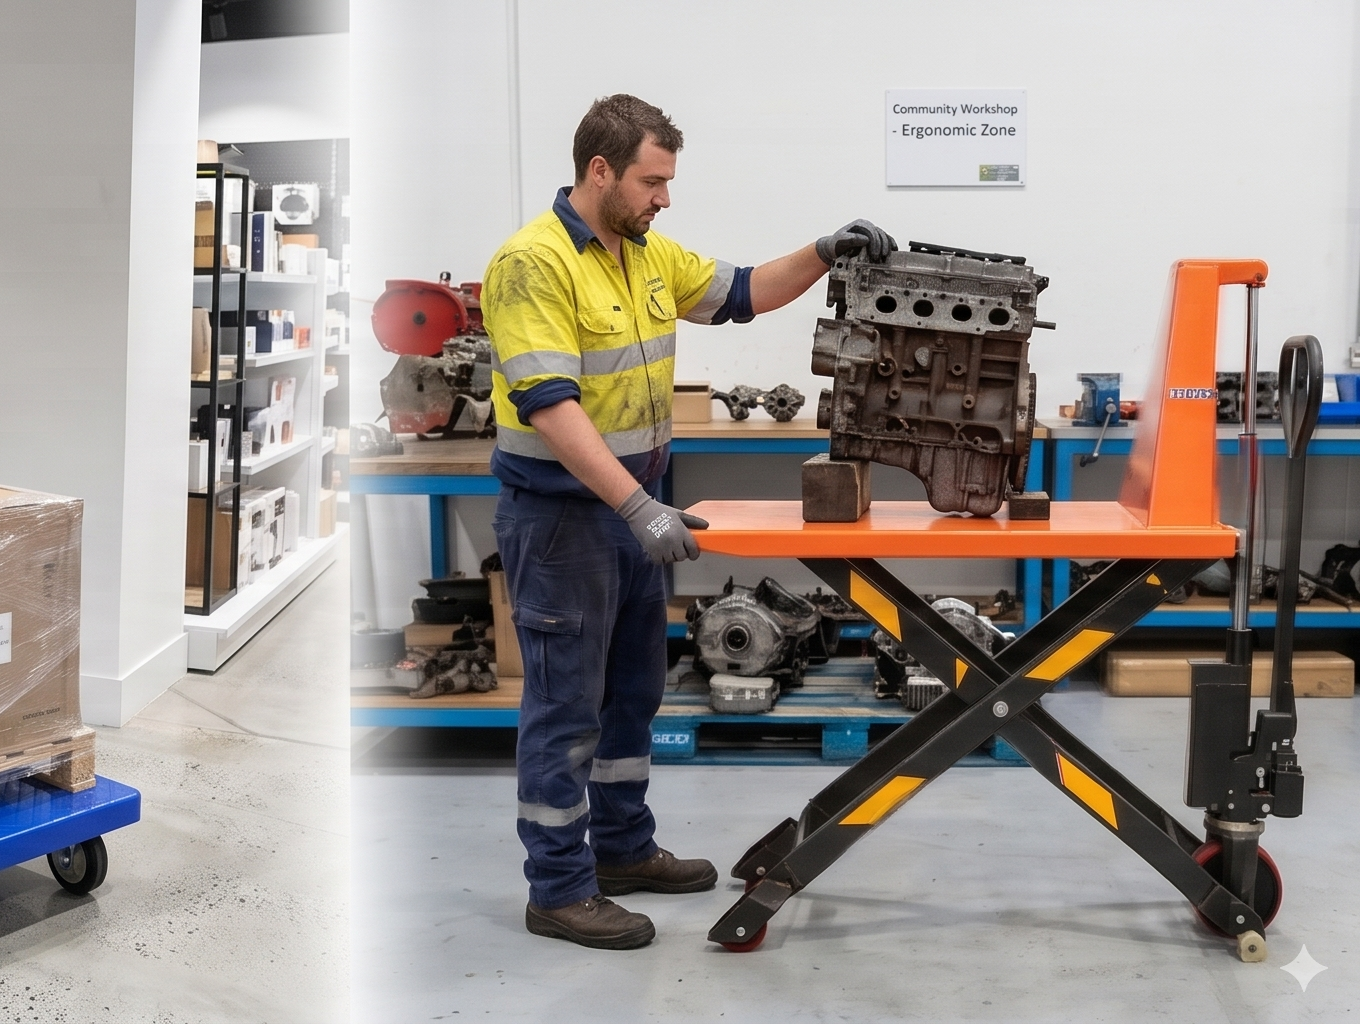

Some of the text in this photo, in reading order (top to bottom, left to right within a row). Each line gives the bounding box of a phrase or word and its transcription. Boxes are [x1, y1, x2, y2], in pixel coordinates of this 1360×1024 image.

[893, 104, 1018, 116] Community Workshop
[902, 124, 977, 139] Ergonomic
[981, 124, 1016, 136] Zone
